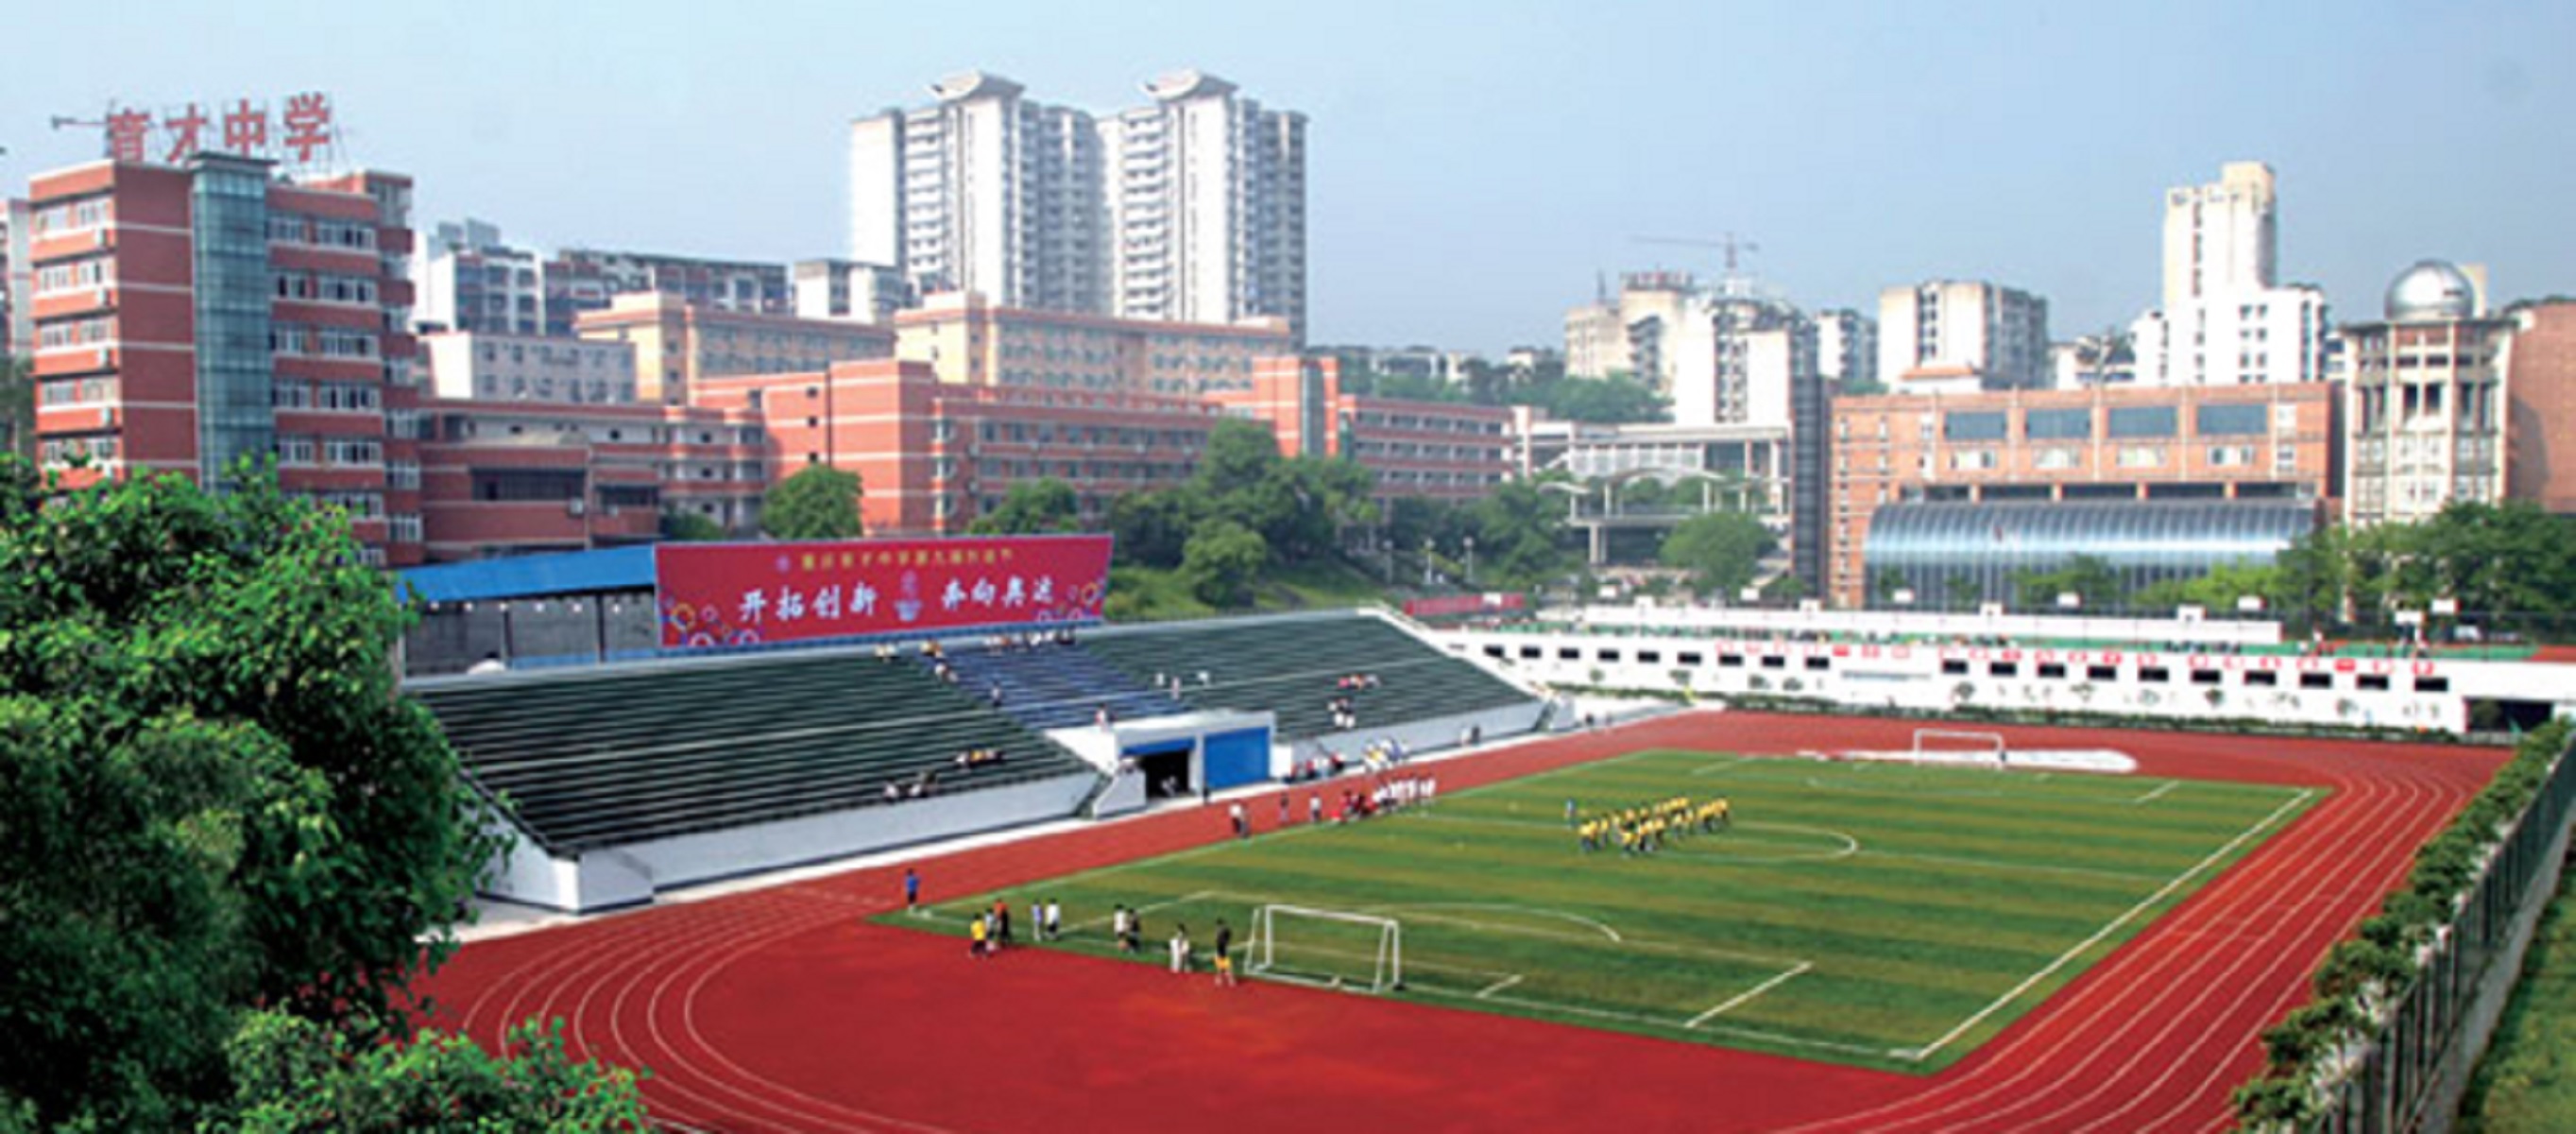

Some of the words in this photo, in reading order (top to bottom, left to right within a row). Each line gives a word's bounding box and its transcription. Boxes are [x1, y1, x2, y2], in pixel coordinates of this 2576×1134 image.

[106, 92, 330, 163] 育才中学
[739, 581, 878, 622] 开拓创新
